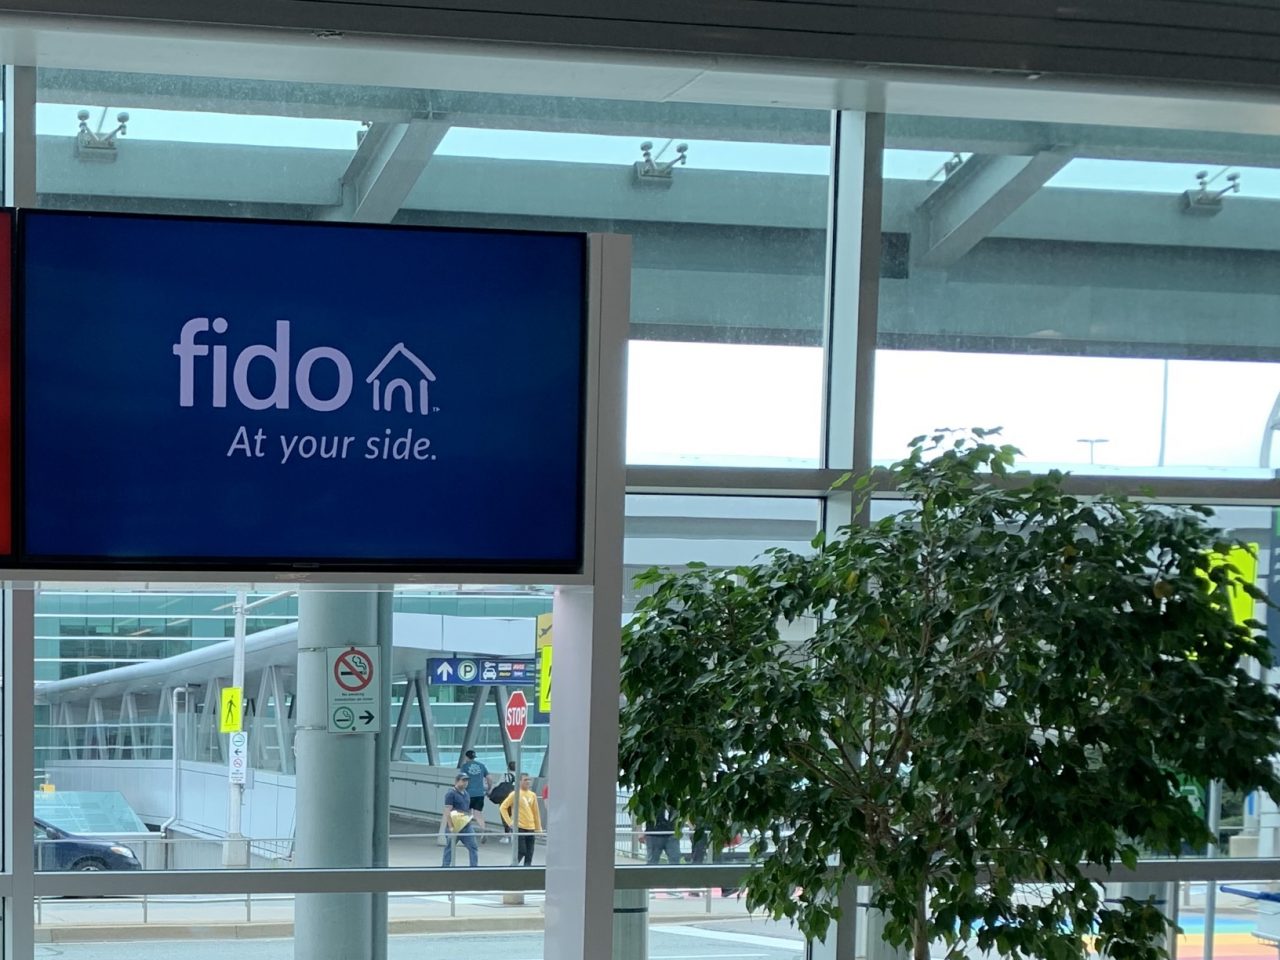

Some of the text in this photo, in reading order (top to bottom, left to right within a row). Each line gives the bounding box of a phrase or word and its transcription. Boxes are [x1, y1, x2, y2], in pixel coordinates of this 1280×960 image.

[172, 317, 354, 412] fido
[226, 425, 437, 464] At your side.
[463, 664, 473, 678] P
[507, 707, 526, 726] STOP
